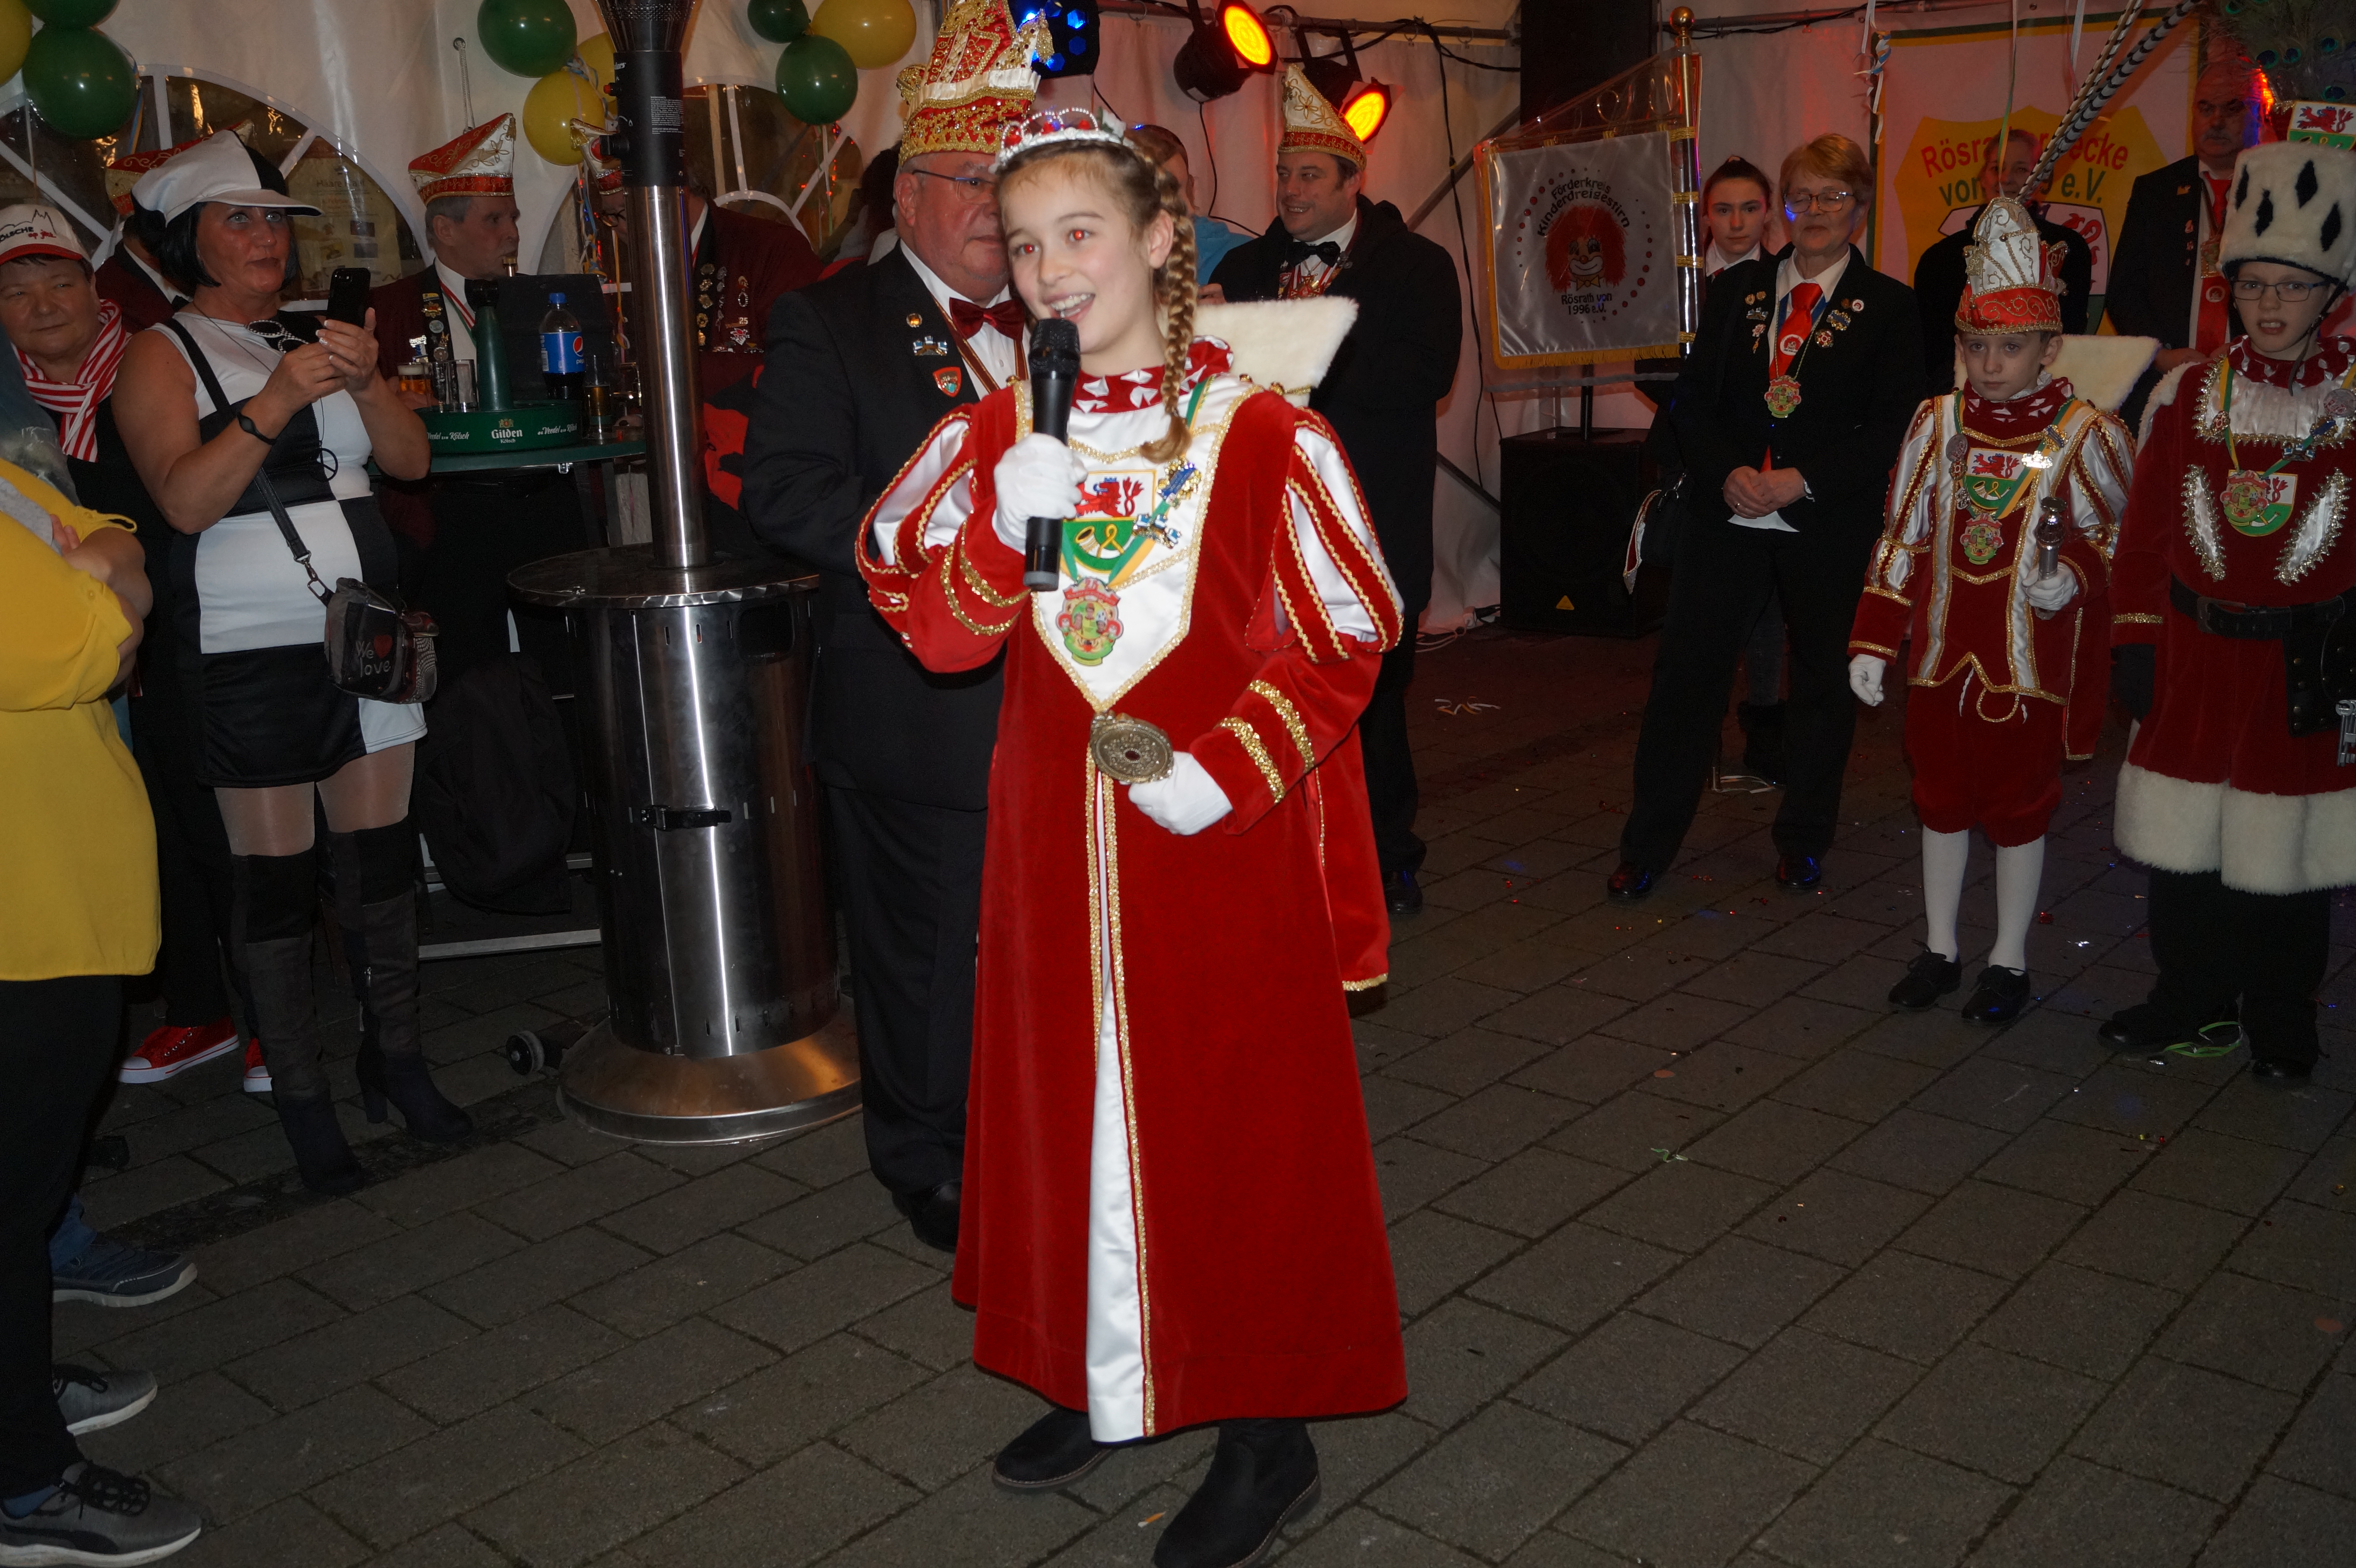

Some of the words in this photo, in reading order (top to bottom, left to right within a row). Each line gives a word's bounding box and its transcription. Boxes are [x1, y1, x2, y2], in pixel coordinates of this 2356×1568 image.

[2067, 133, 2128, 170] ecke
[1551, 177, 1612, 200] Förderkreis
[1939, 177, 1986, 206] von
[2061, 168, 2106, 203] e.V.
[1537, 189, 1630, 236] Kinderdreigestirn
[0, 226, 34, 242] ÖLSCHE
[1561, 293, 1594, 305] Rösrath
[1597, 293, 1612, 302] von
[1568, 304, 1590, 315] 1996
[1592, 303, 1606, 313] e.V.
[450, 432, 469, 441] Kölsch
[491, 429, 523, 439] Gilden
[355, 641, 374, 659] We
[360, 657, 391, 678] love
